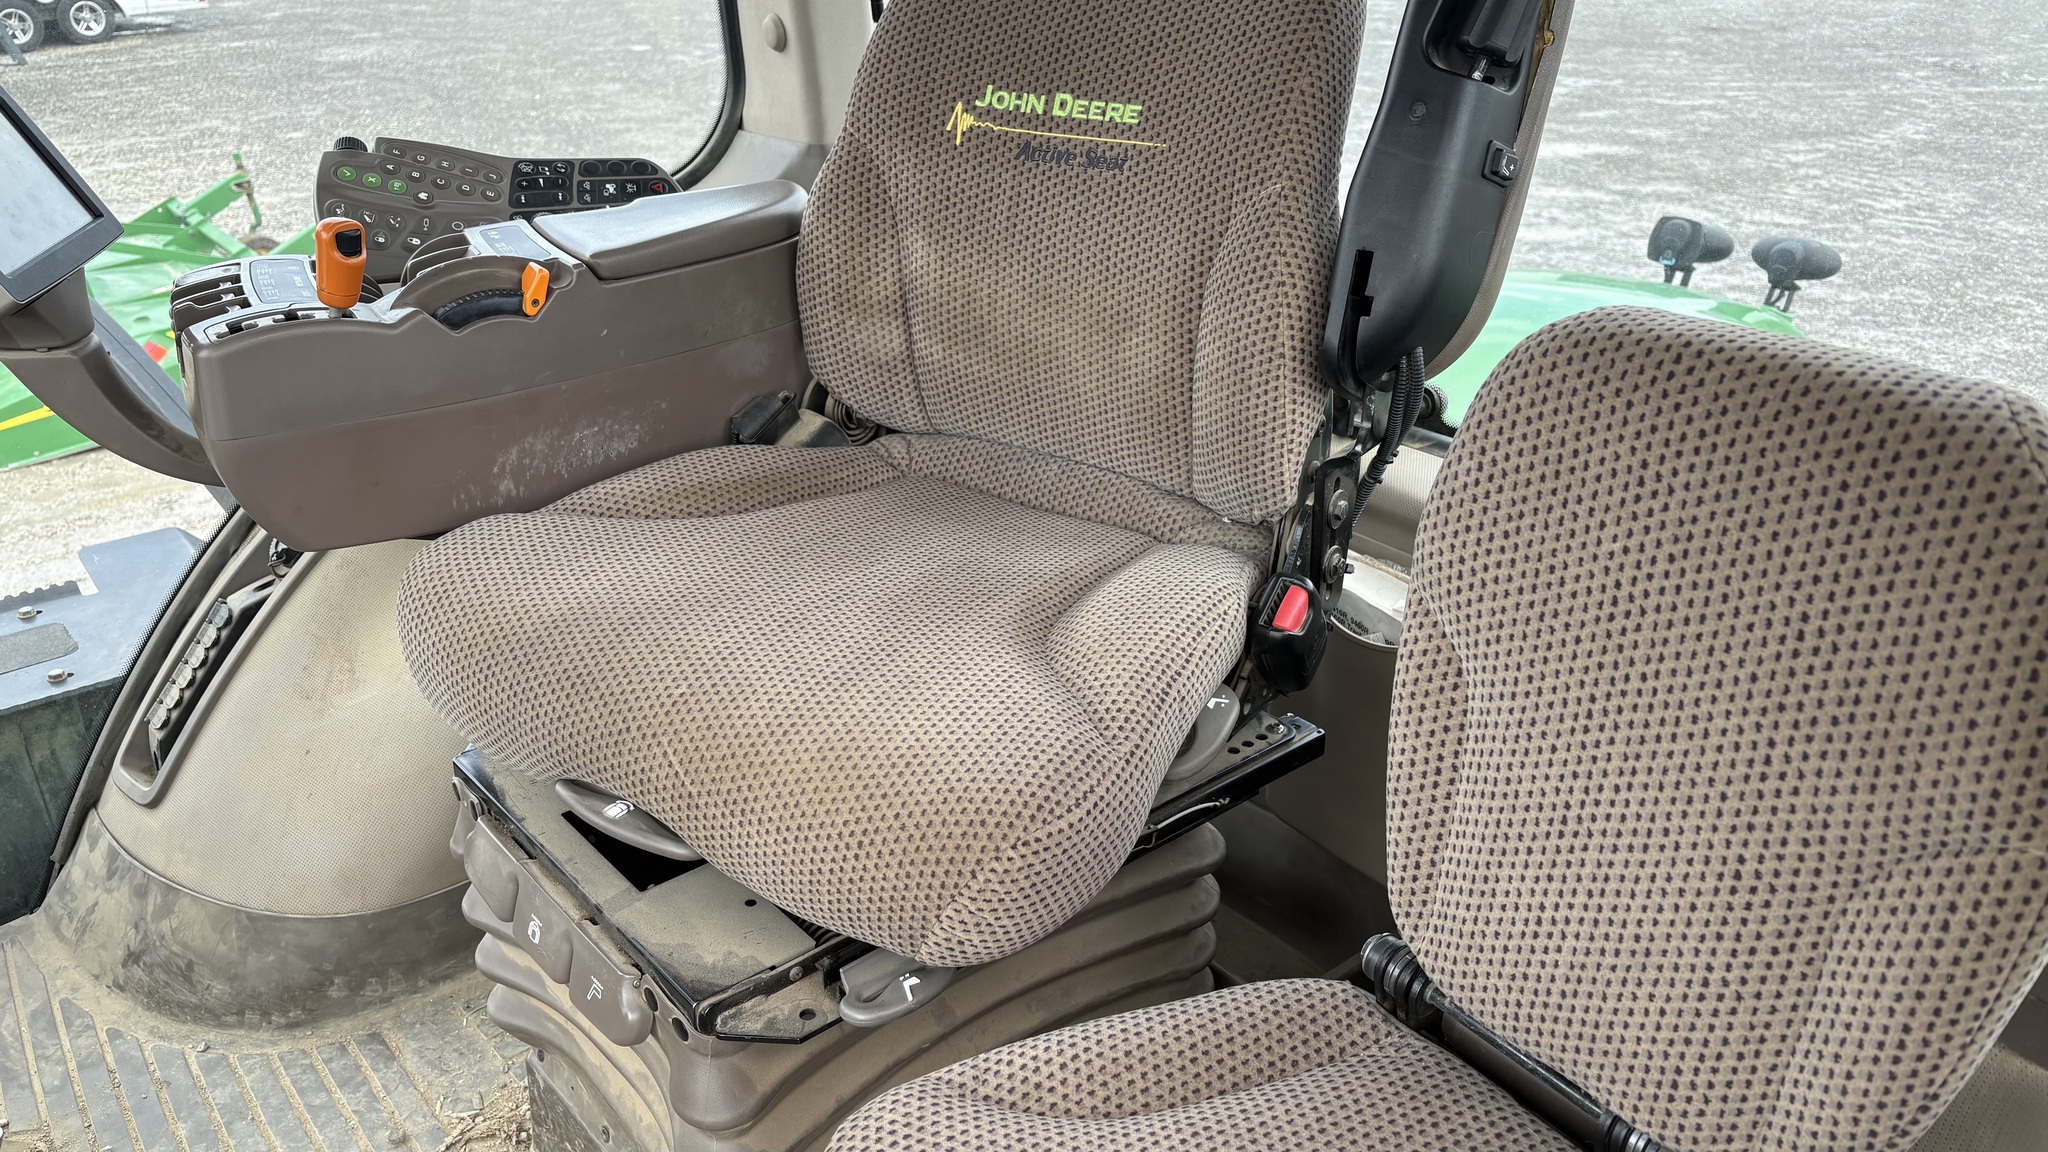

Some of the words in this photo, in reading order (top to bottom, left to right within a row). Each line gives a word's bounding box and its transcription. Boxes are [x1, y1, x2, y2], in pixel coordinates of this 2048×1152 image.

[975, 84, 1046, 115] JOHN
[1052, 92, 1143, 124] DEERE
[441, 160, 450, 168] H
[1014, 140, 1078, 167] Active
[1082, 147, 1130, 172] Seat
